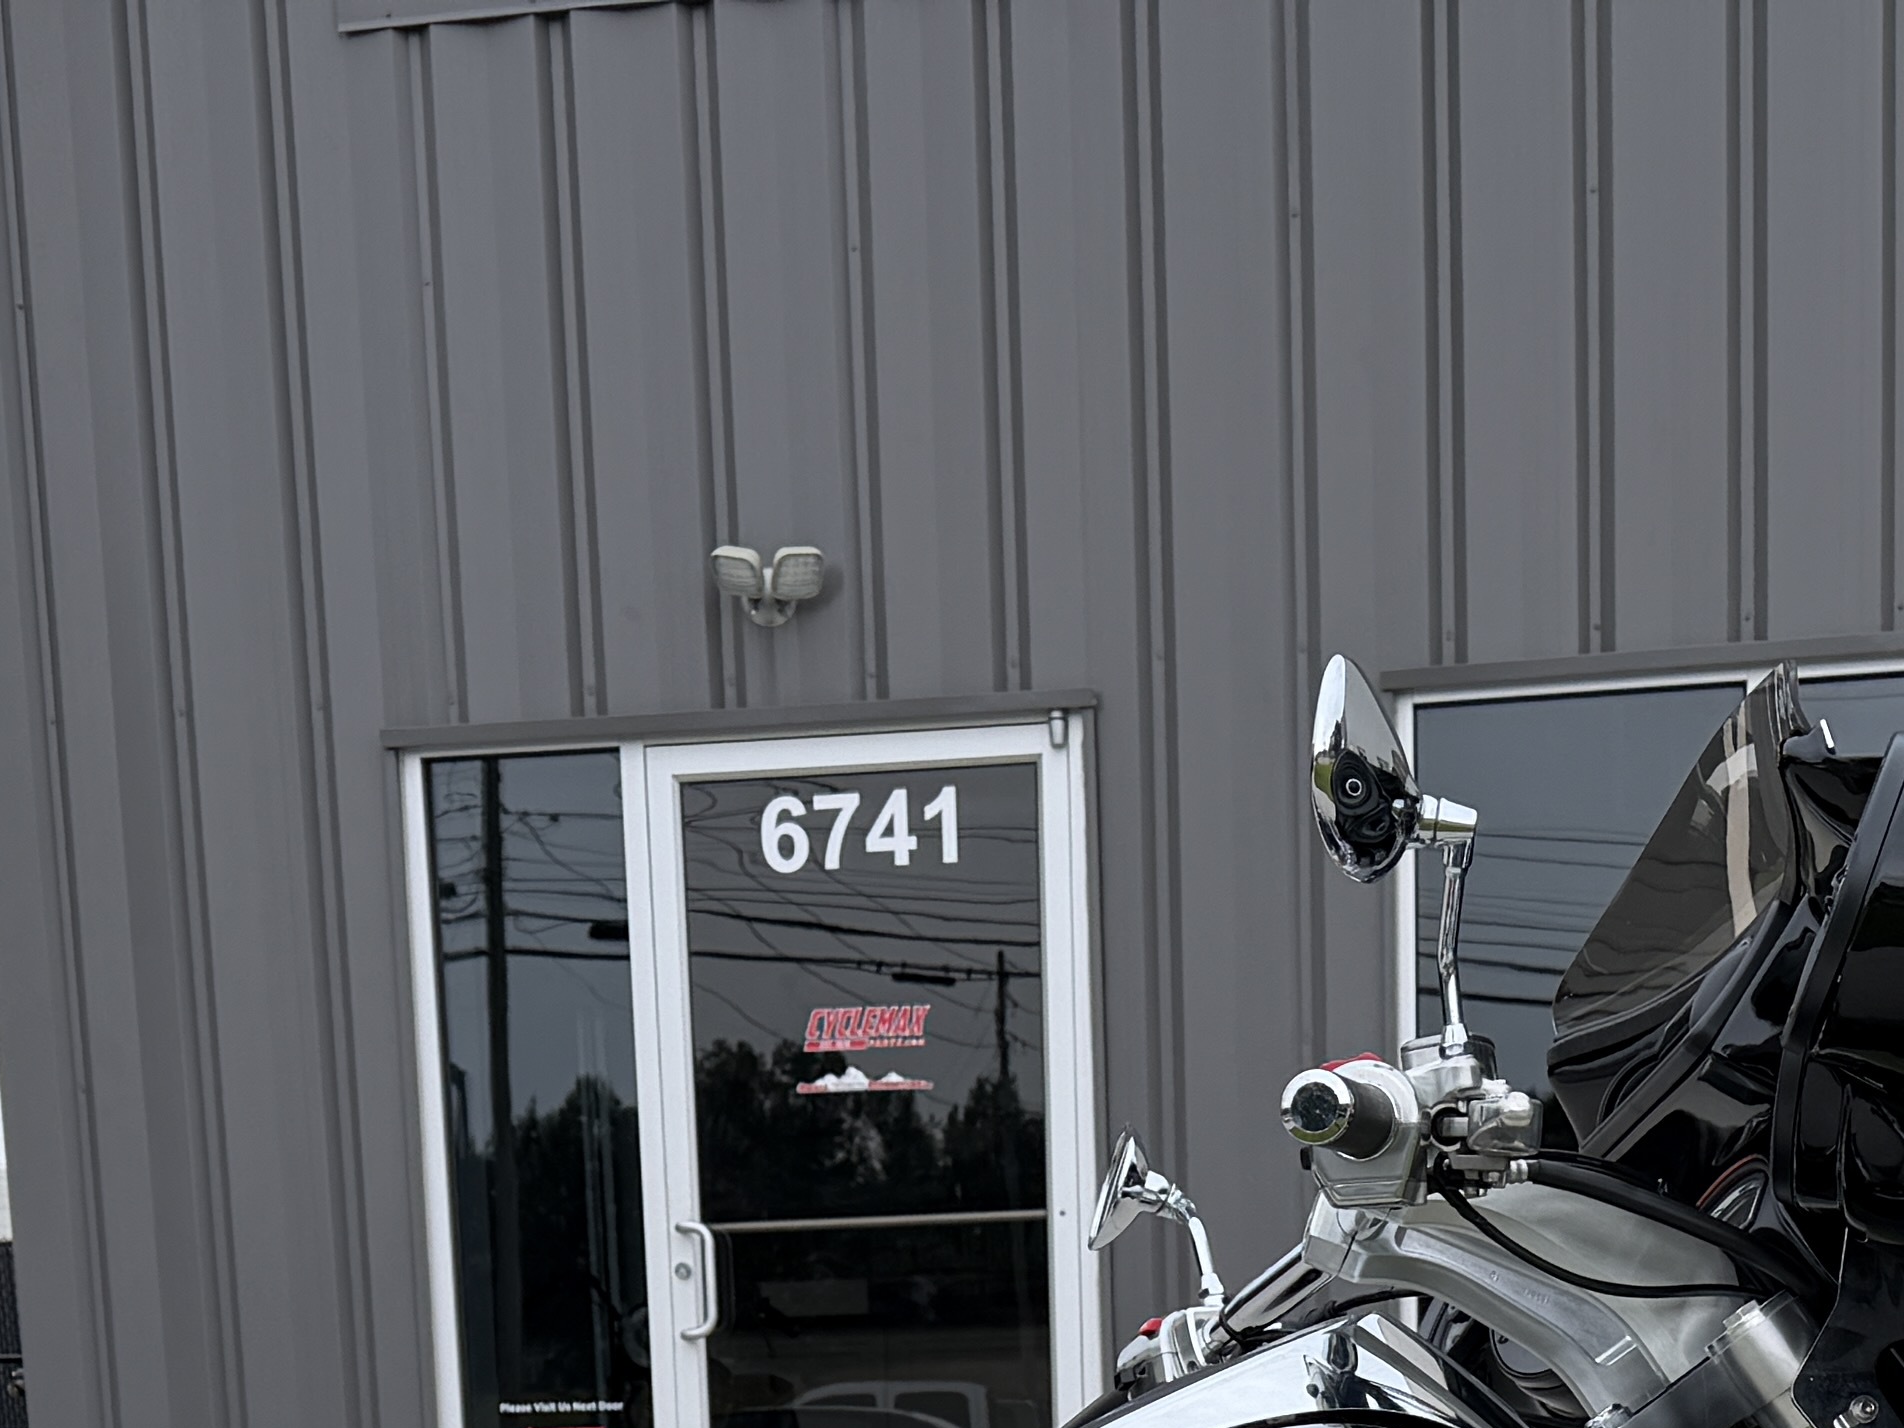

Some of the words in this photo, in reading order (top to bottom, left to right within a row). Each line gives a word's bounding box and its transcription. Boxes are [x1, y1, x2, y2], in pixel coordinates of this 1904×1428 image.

[761, 784, 959, 873] 6741
[804, 1004, 932, 1040] CYCLEMAX
[499, 1402, 533, 1414] Please
[533, 1402, 557, 1413] Visit
[557, 1402, 572, 1413] Us
[572, 1401, 597, 1412] Next
[598, 1400, 624, 1412] Door
